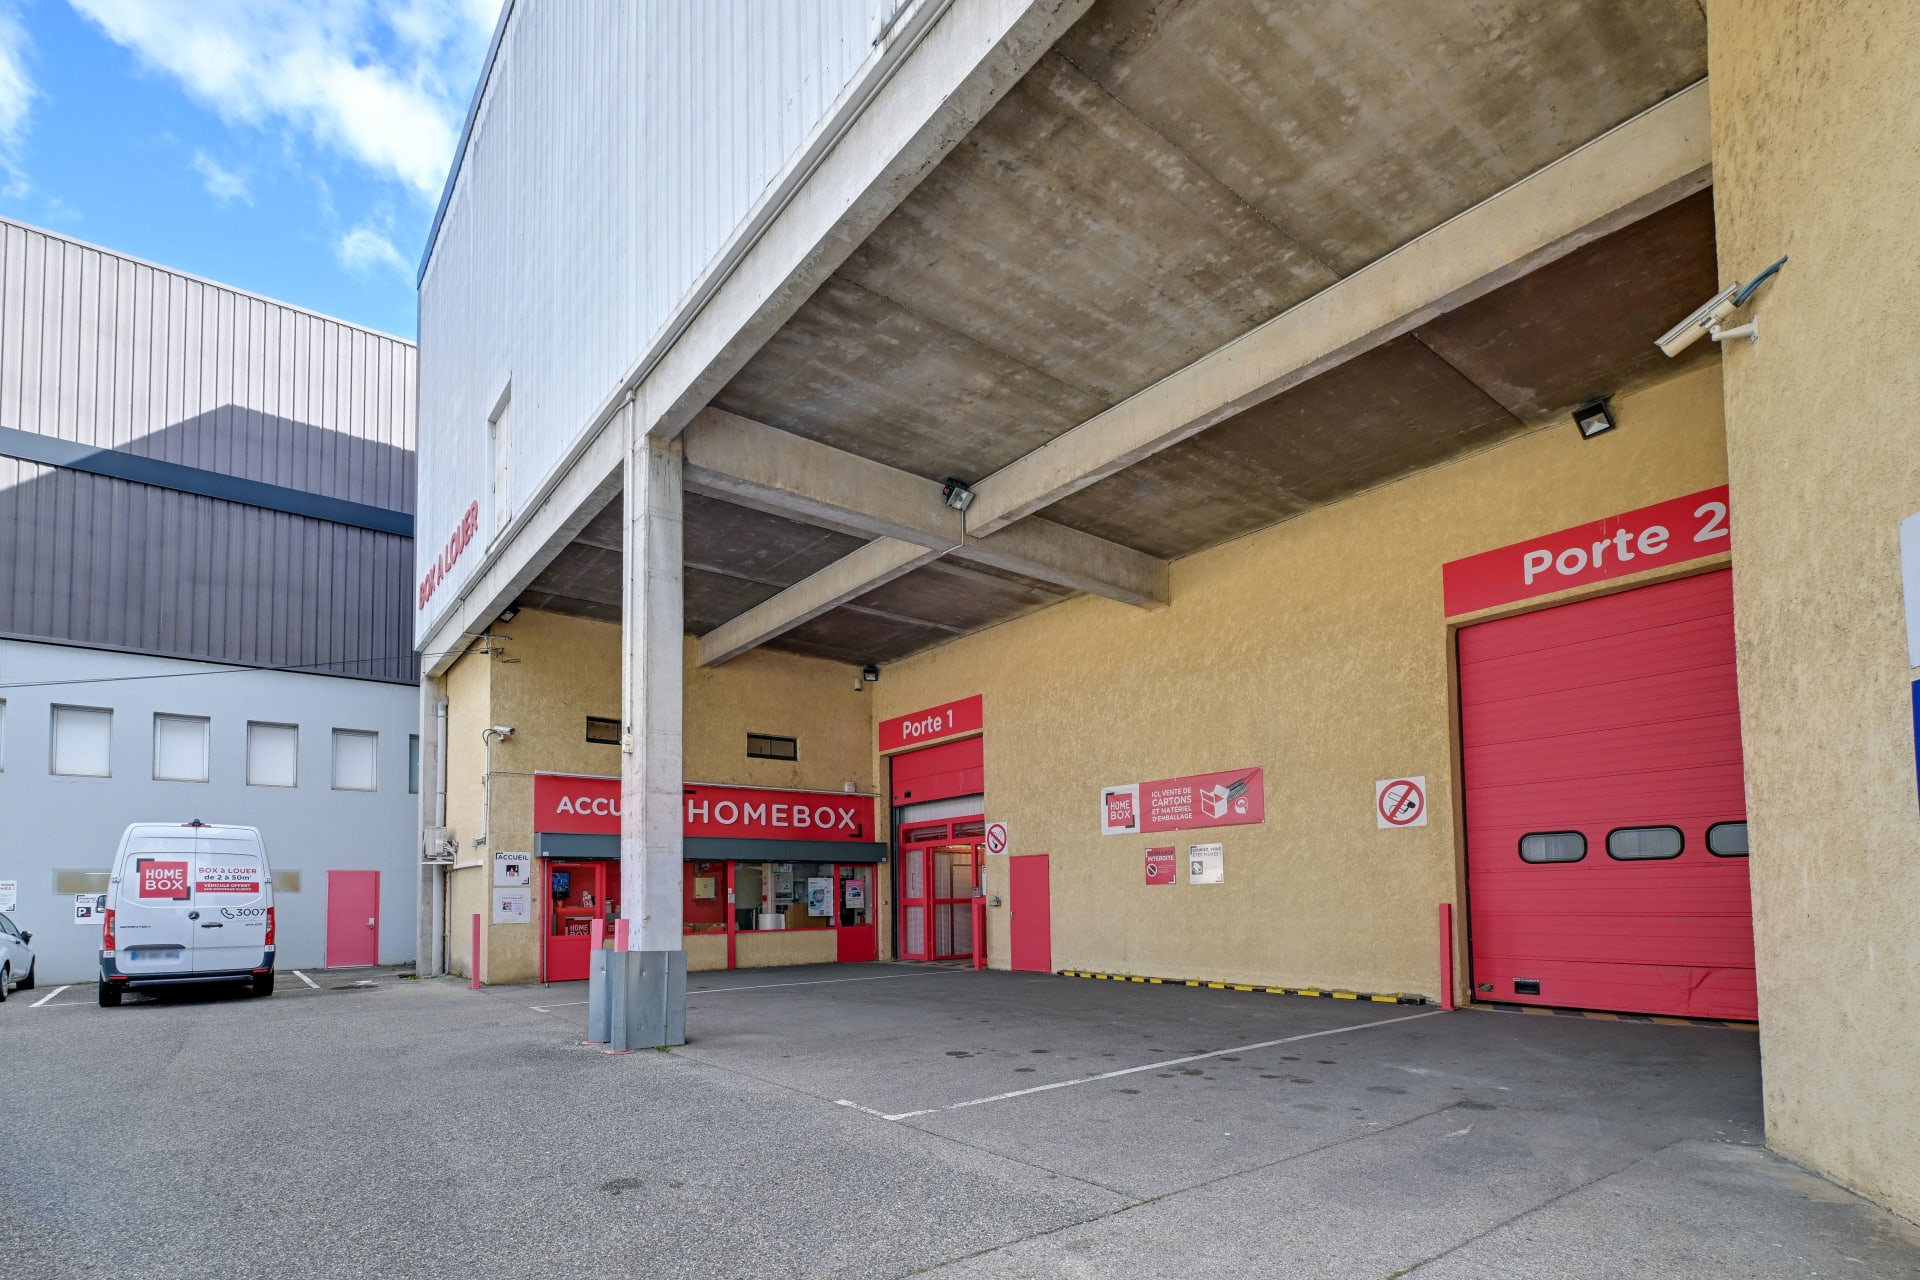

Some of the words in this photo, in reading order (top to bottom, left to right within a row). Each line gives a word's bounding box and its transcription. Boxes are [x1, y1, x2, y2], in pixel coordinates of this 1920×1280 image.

[1523, 525, 1670, 585] Porte
[1693, 501, 1729, 543] 2
[419, 563, 435, 610] BOX
[437, 553, 443, 586] A
[445, 500, 478, 573] LOUER
[903, 716, 942, 740] Porte
[947, 709, 953, 728] 1
[1162, 788, 1181, 796] VENTE
[1110, 800, 1130, 811] HOME
[1151, 796, 1192, 807] CARTONS
[556, 796, 621, 816] ACCU
[688, 799, 857, 830] HOMEBOX
[1161, 805, 1192, 814] MATÉRIEL
[1110, 810, 1131, 820] BOX
[1152, 813, 1192, 822] D'EMBALLAGE
[145, 869, 184, 879] HOME
[145, 880, 183, 890] BOX
[236, 908, 266, 917] 3007
